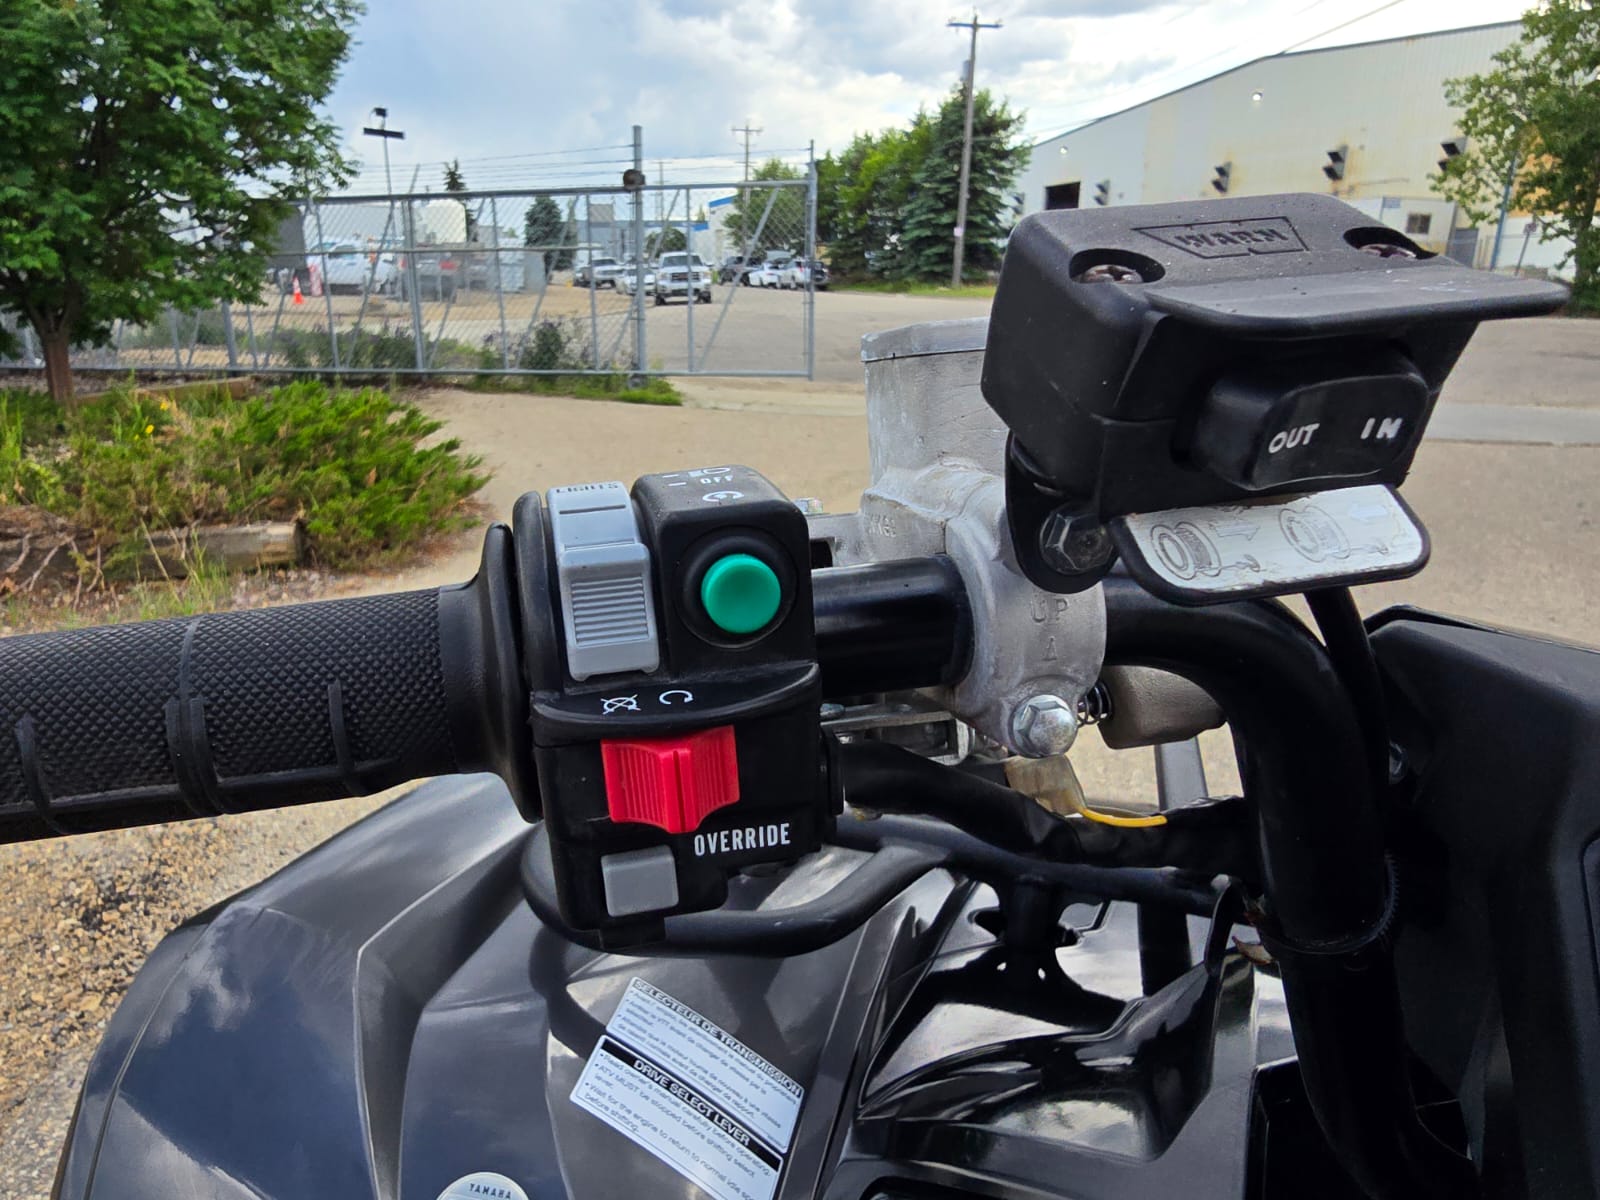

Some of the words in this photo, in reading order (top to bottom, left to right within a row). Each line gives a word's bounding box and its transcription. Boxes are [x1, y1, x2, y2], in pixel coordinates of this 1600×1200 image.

[1268, 423, 1320, 454] OUT
[1360, 417, 1403, 439] IN
[700, 475, 733, 484] OFF
[694, 823, 791, 856] OVERRIDE
[634, 979, 702, 1025] SELECTEUR
[700, 1021, 720, 1037] DE
[718, 1033, 802, 1096] TRANSMISSION
[598, 1064, 616, 1078] ATV
[614, 1074, 640, 1093] MUST
[632, 1059, 670, 1087] DRIVE
[668, 1082, 714, 1117] SELECT
[712, 1113, 751, 1146] LEVER
[589, 1084, 606, 1097] Wait
[618, 1103, 633, 1115] the
[632, 1112, 659, 1133] engine
[667, 1136, 691, 1155] return
[700, 1159, 727, 1182] normal
[469, 1183, 512, 1199] YAMAHA
